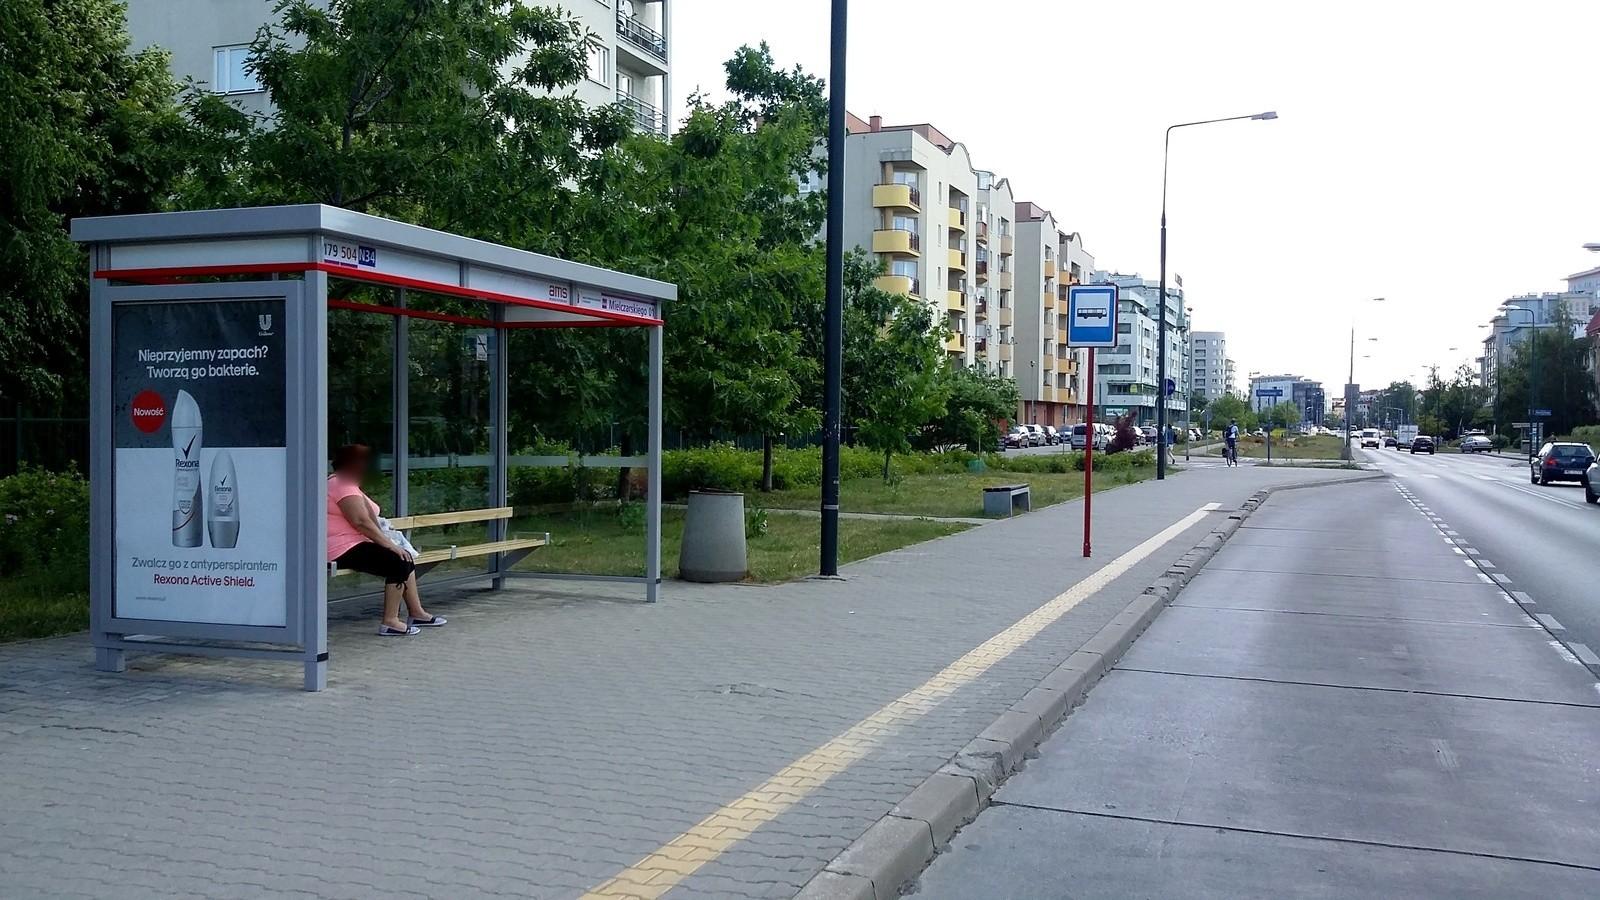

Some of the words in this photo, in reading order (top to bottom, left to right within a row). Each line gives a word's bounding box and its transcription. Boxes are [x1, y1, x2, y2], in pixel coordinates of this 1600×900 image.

[324, 243, 338, 257] 179
[341, 246, 357, 261] 504
[359, 247, 376, 263] N34
[549, 285, 568, 299] ams
[608, 299, 647, 317] Mielczarskiego
[138, 349, 216, 362] Nieprzyjemny
[217, 345, 269, 360] zapach?
[147, 366, 189, 379] Tworzą
[191, 368, 207, 380] go
[208, 363, 260, 377] bakterie.
[133, 407, 164, 417] Nowość
[175, 458, 200, 468] Rexona
[132, 557, 167, 569] Zwalcz
[168, 559, 182, 571] go
[184, 560, 189, 568] z
[190, 559, 278, 572] antyperspirantem
[154, 574, 190, 585] Rexona
[191, 575, 222, 586] Active
[223, 576, 256, 587] Shield.
